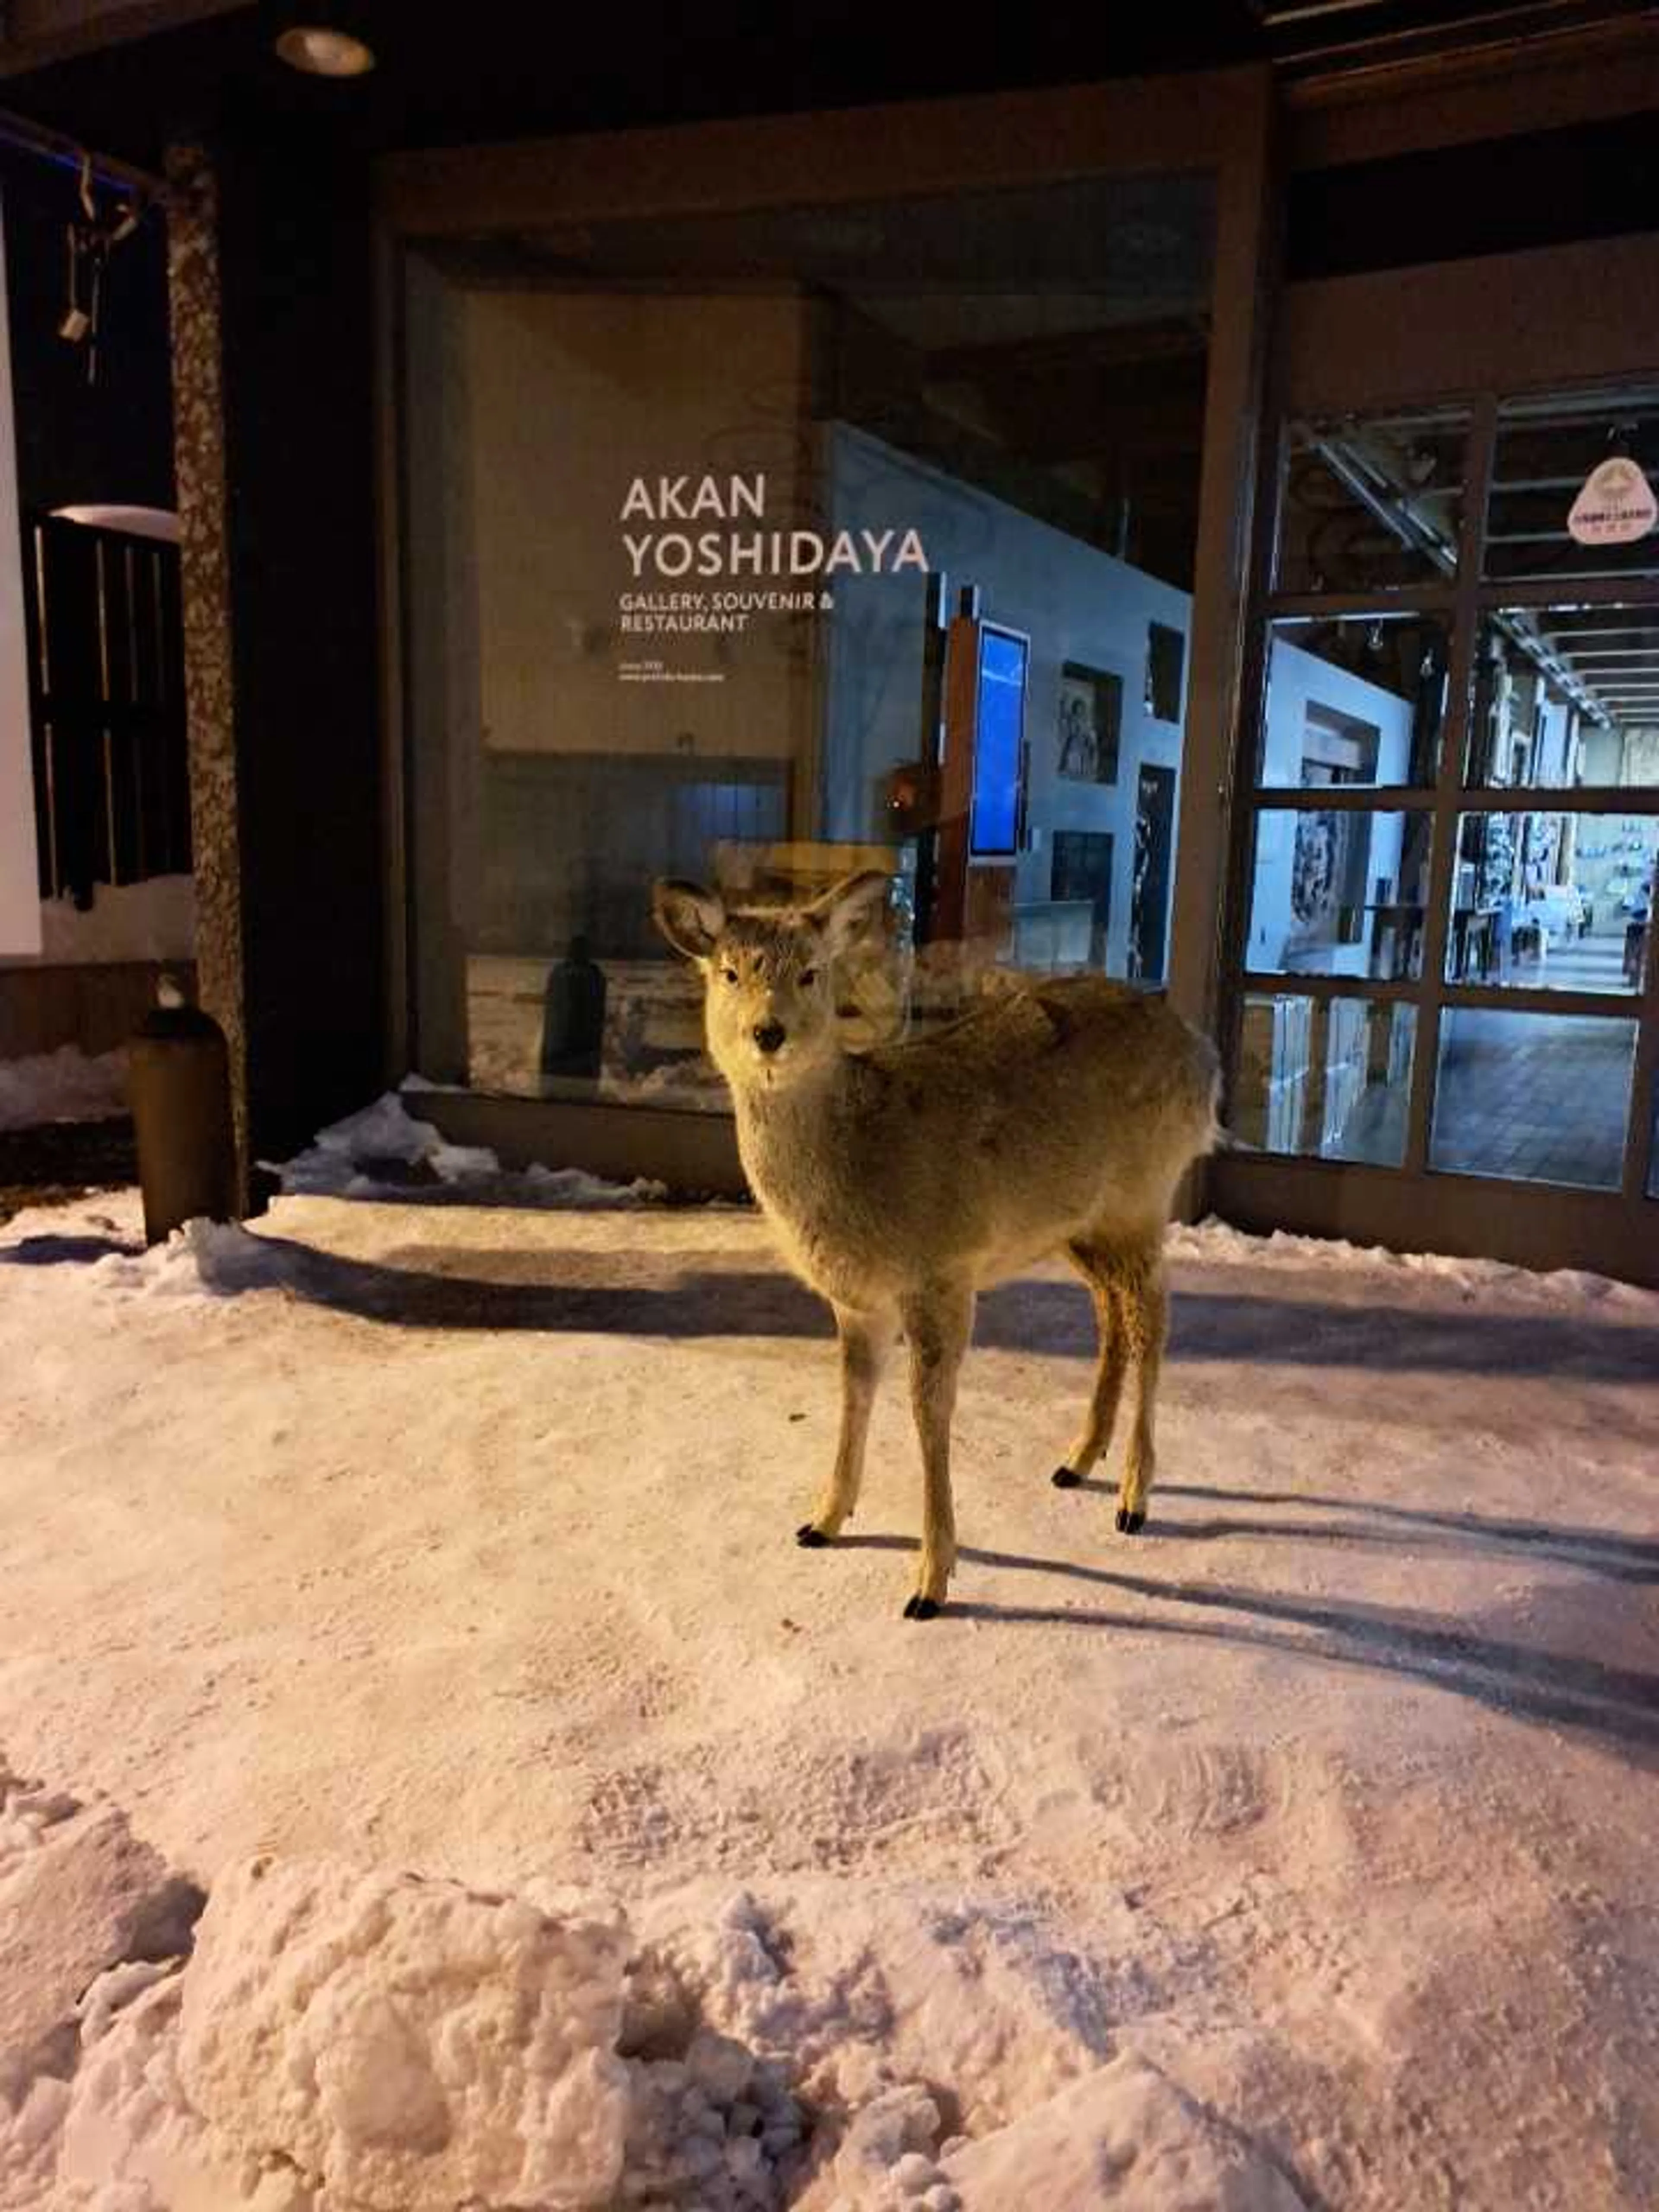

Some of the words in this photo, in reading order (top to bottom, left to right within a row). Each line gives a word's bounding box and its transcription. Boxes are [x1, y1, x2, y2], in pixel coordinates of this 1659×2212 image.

[620, 474, 765, 519] AKAN
[623, 528, 929, 576] YOSHIDAYA
[620, 592, 709, 612] GALLERY,
[712, 591, 815, 610] SOUVENIR
[621, 613, 749, 631] RESTAURANT
